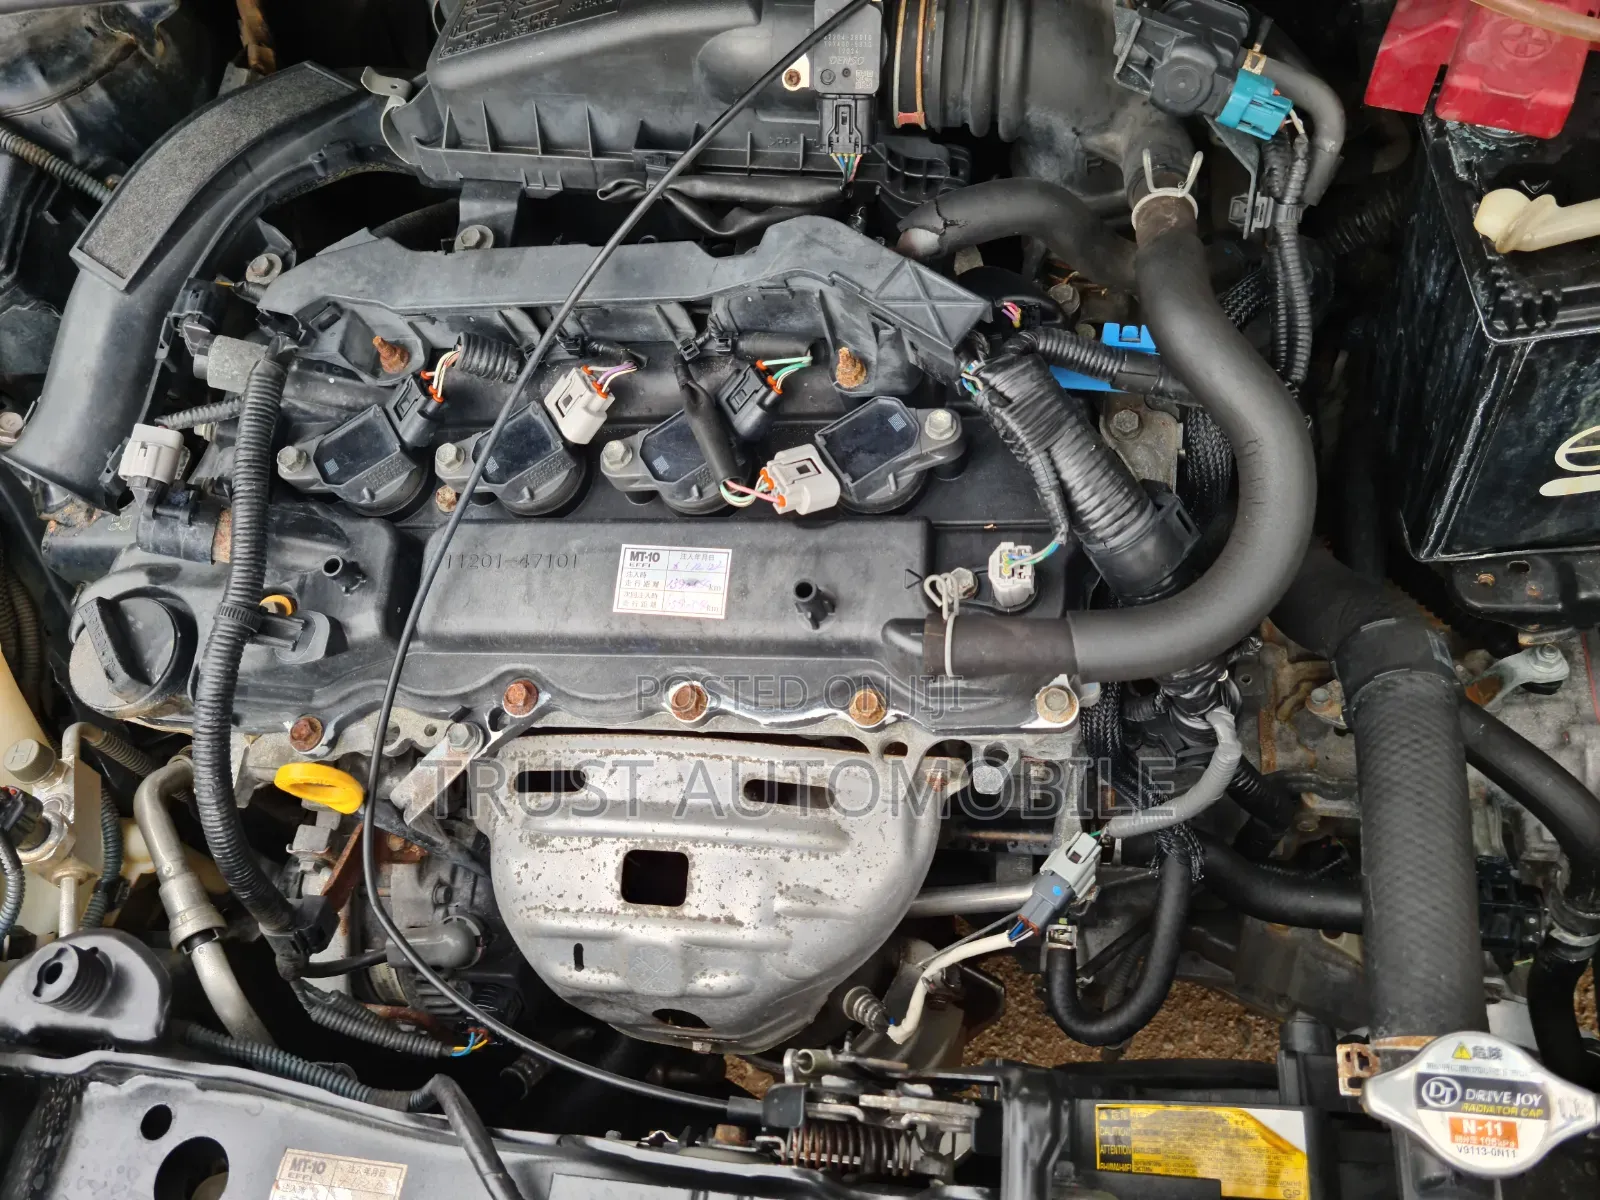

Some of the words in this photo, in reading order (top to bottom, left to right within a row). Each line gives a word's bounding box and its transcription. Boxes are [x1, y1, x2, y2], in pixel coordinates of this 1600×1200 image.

[829, 56, 865, 66] DENSO
[447, 553, 577, 569] 11201-47101
[629, 551, 660, 562] MT-10
[1465, 1088, 1512, 1104] DRIVE
[1513, 1093, 1543, 1107] JOY
[1461, 1102, 1519, 1116] RADIATOR
[1521, 1107, 1544, 1118] CAP
[1100, 1126, 1131, 1136] CAUTION
[1462, 1119, 1503, 1136] N-11
[1100, 1144, 1132, 1155] ATTENTION
[1456, 1144, 1516, 1158] V9113-0N11
[289, 1157, 326, 1175] MT-10
